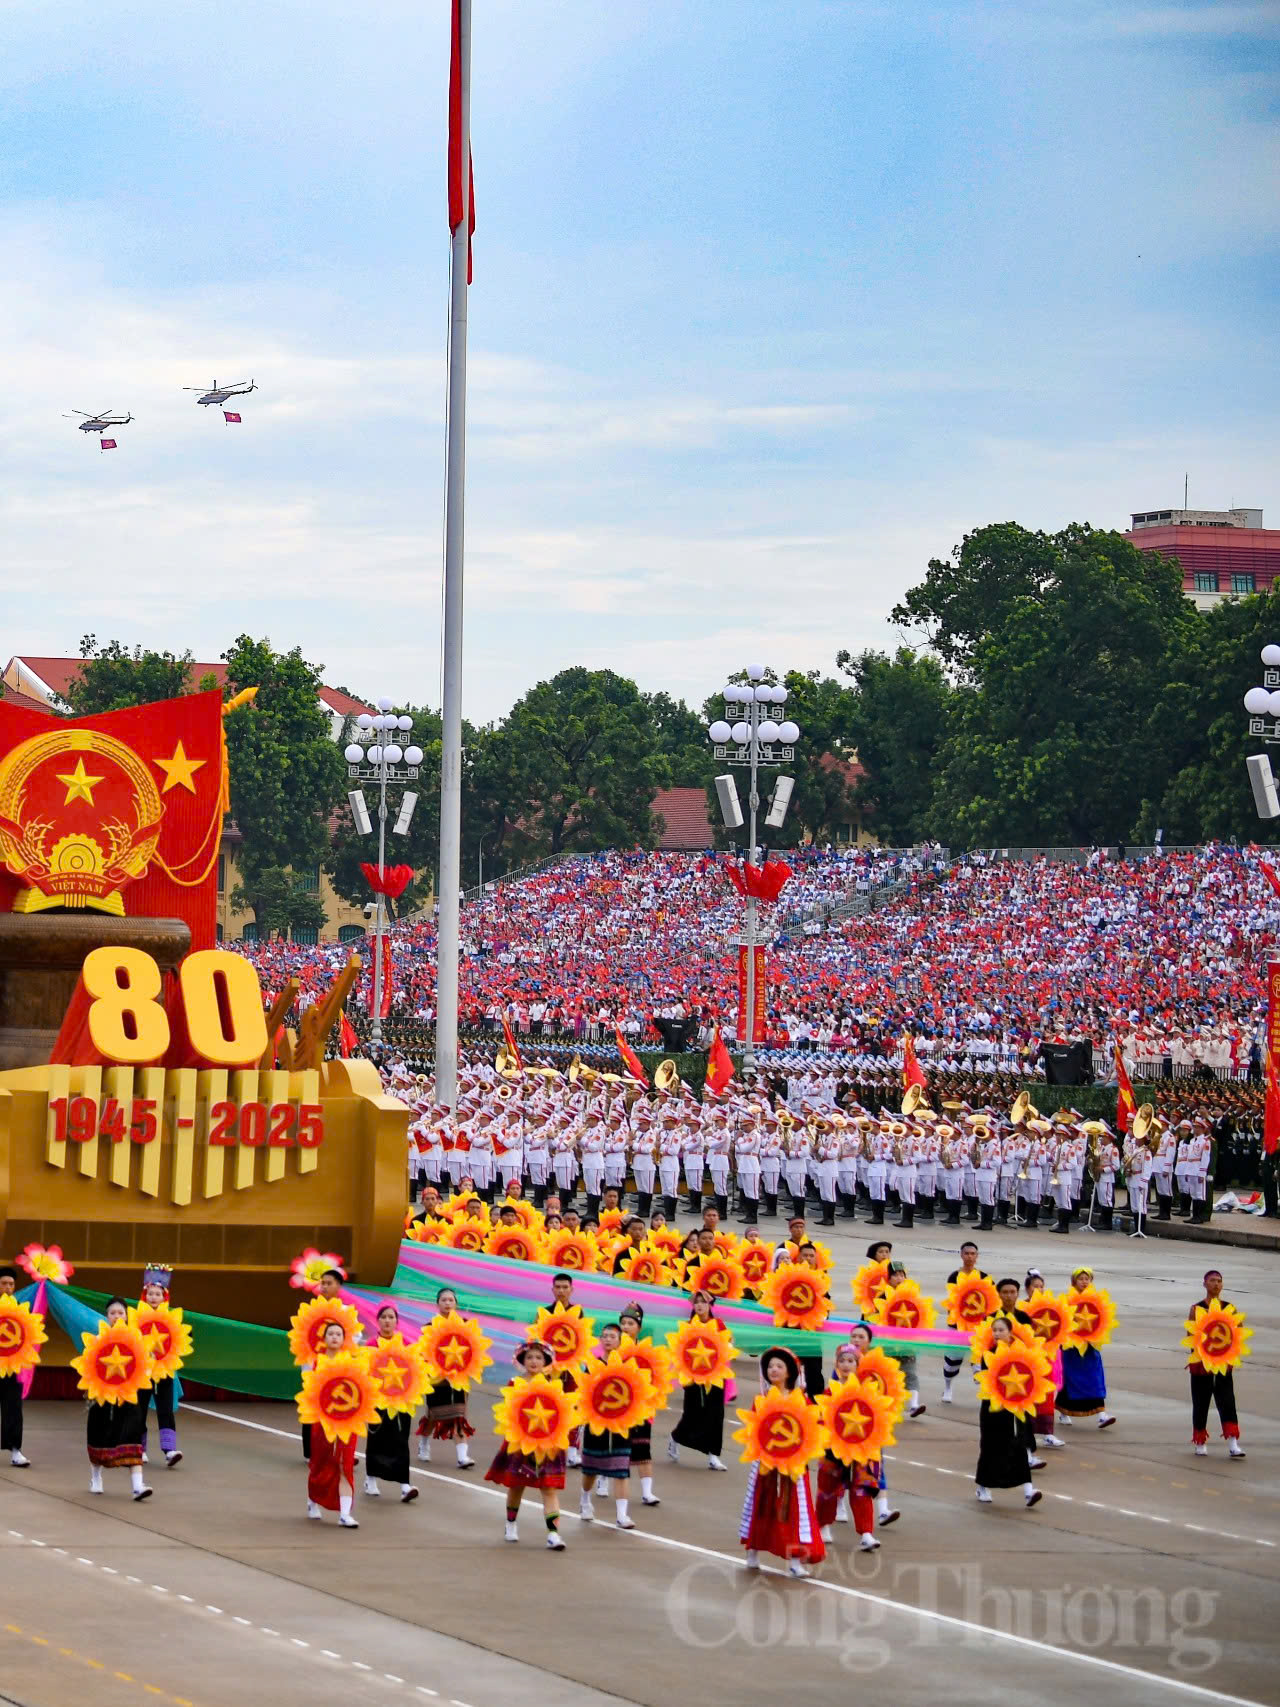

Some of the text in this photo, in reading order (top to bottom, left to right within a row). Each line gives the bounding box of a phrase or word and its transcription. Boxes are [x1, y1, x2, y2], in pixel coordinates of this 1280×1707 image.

[51, 880, 104, 894] VIỆT NAM
[83, 946, 269, 1065] 80
[49, 1096, 324, 1149] 1945 - 2025
